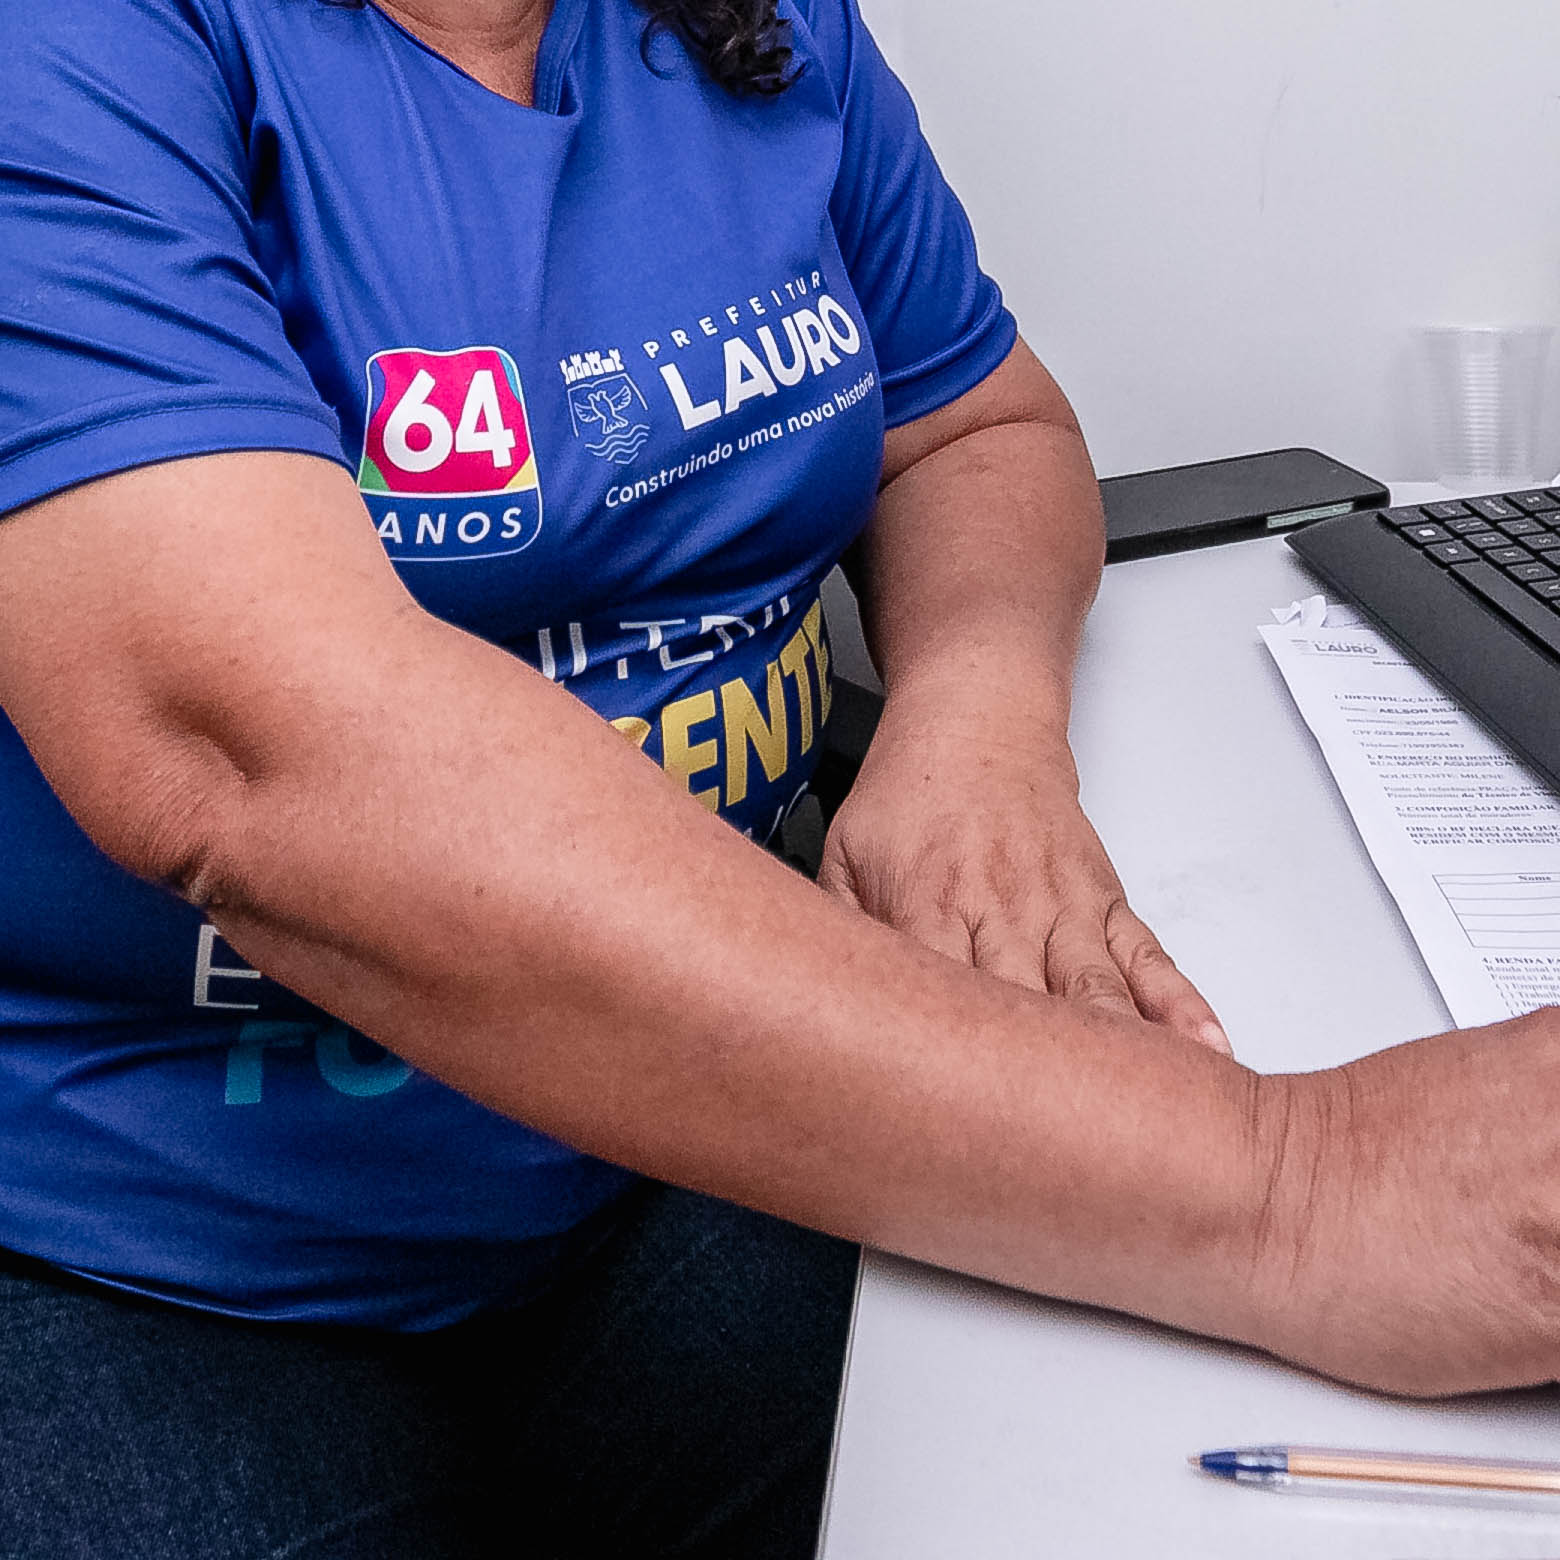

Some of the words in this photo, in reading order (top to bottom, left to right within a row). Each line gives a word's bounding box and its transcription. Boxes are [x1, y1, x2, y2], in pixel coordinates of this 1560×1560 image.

[383, 368, 515, 474] 64
[659, 293, 862, 431] LAURO
[605, 442, 733, 509] Construindo
[738, 419, 784, 452] uma
[787, 404, 836, 437] nova
[835, 371, 876, 419] história
[376, 507, 523, 545] ANOS
[610, 598, 832, 812] ENT
[1315, 643, 1378, 654] LAURO
